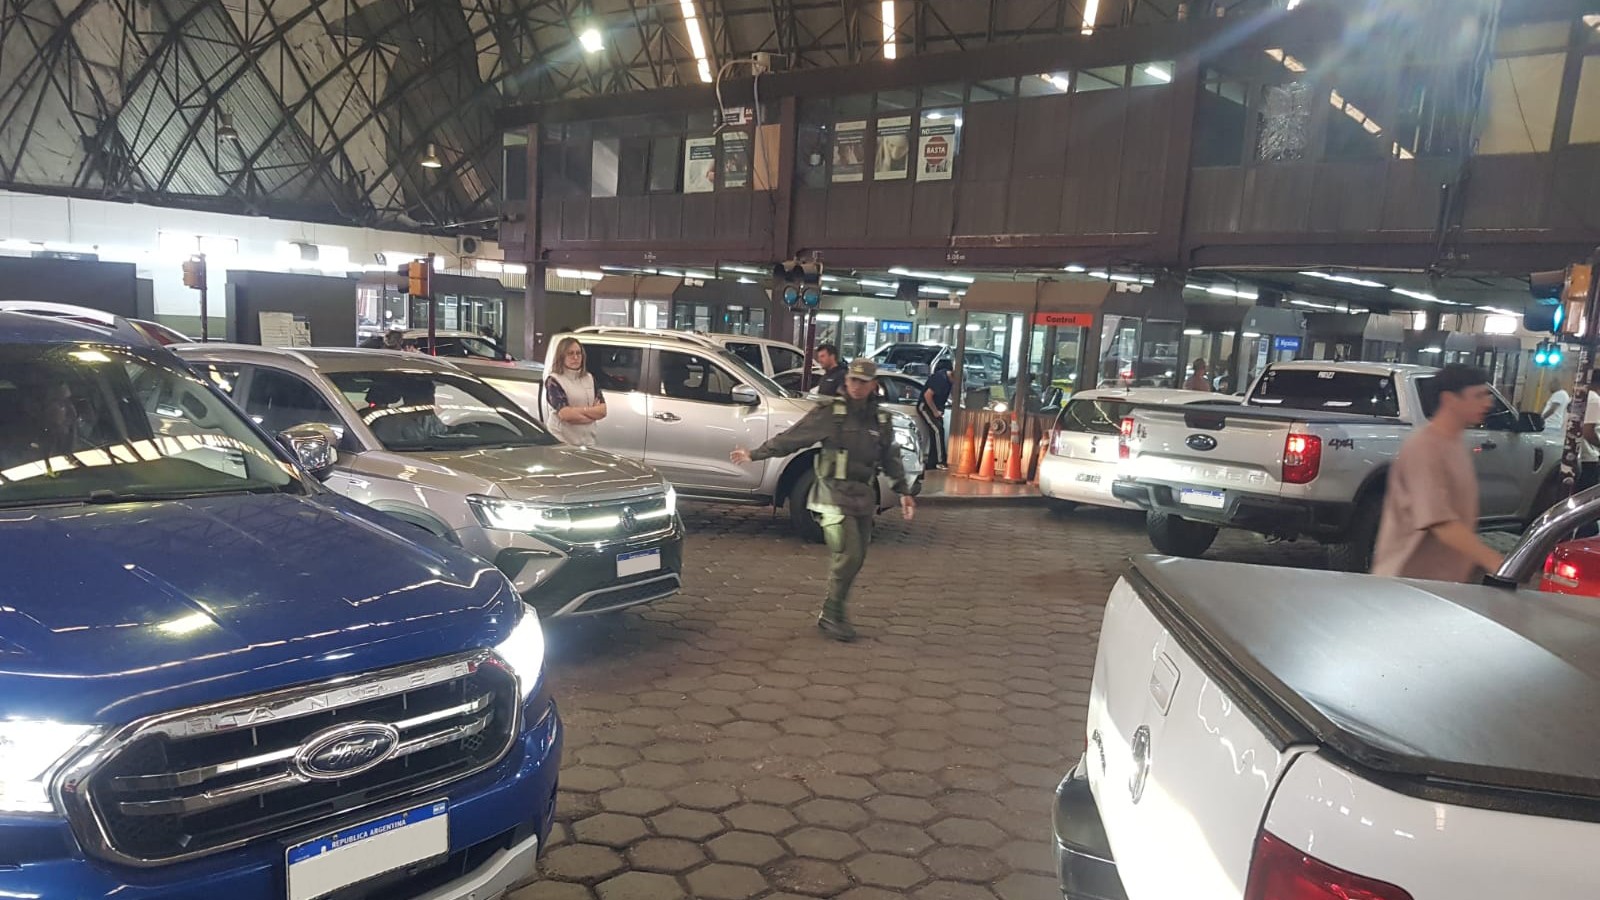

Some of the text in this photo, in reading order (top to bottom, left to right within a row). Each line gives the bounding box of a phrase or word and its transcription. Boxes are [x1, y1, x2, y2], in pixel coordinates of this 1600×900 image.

[926, 146, 946, 154] BASTA
[1046, 315, 1076, 323] Control
[320, 737, 383, 765] Ford
[331, 819, 407, 849] REPUBLICA ARGENTINA
